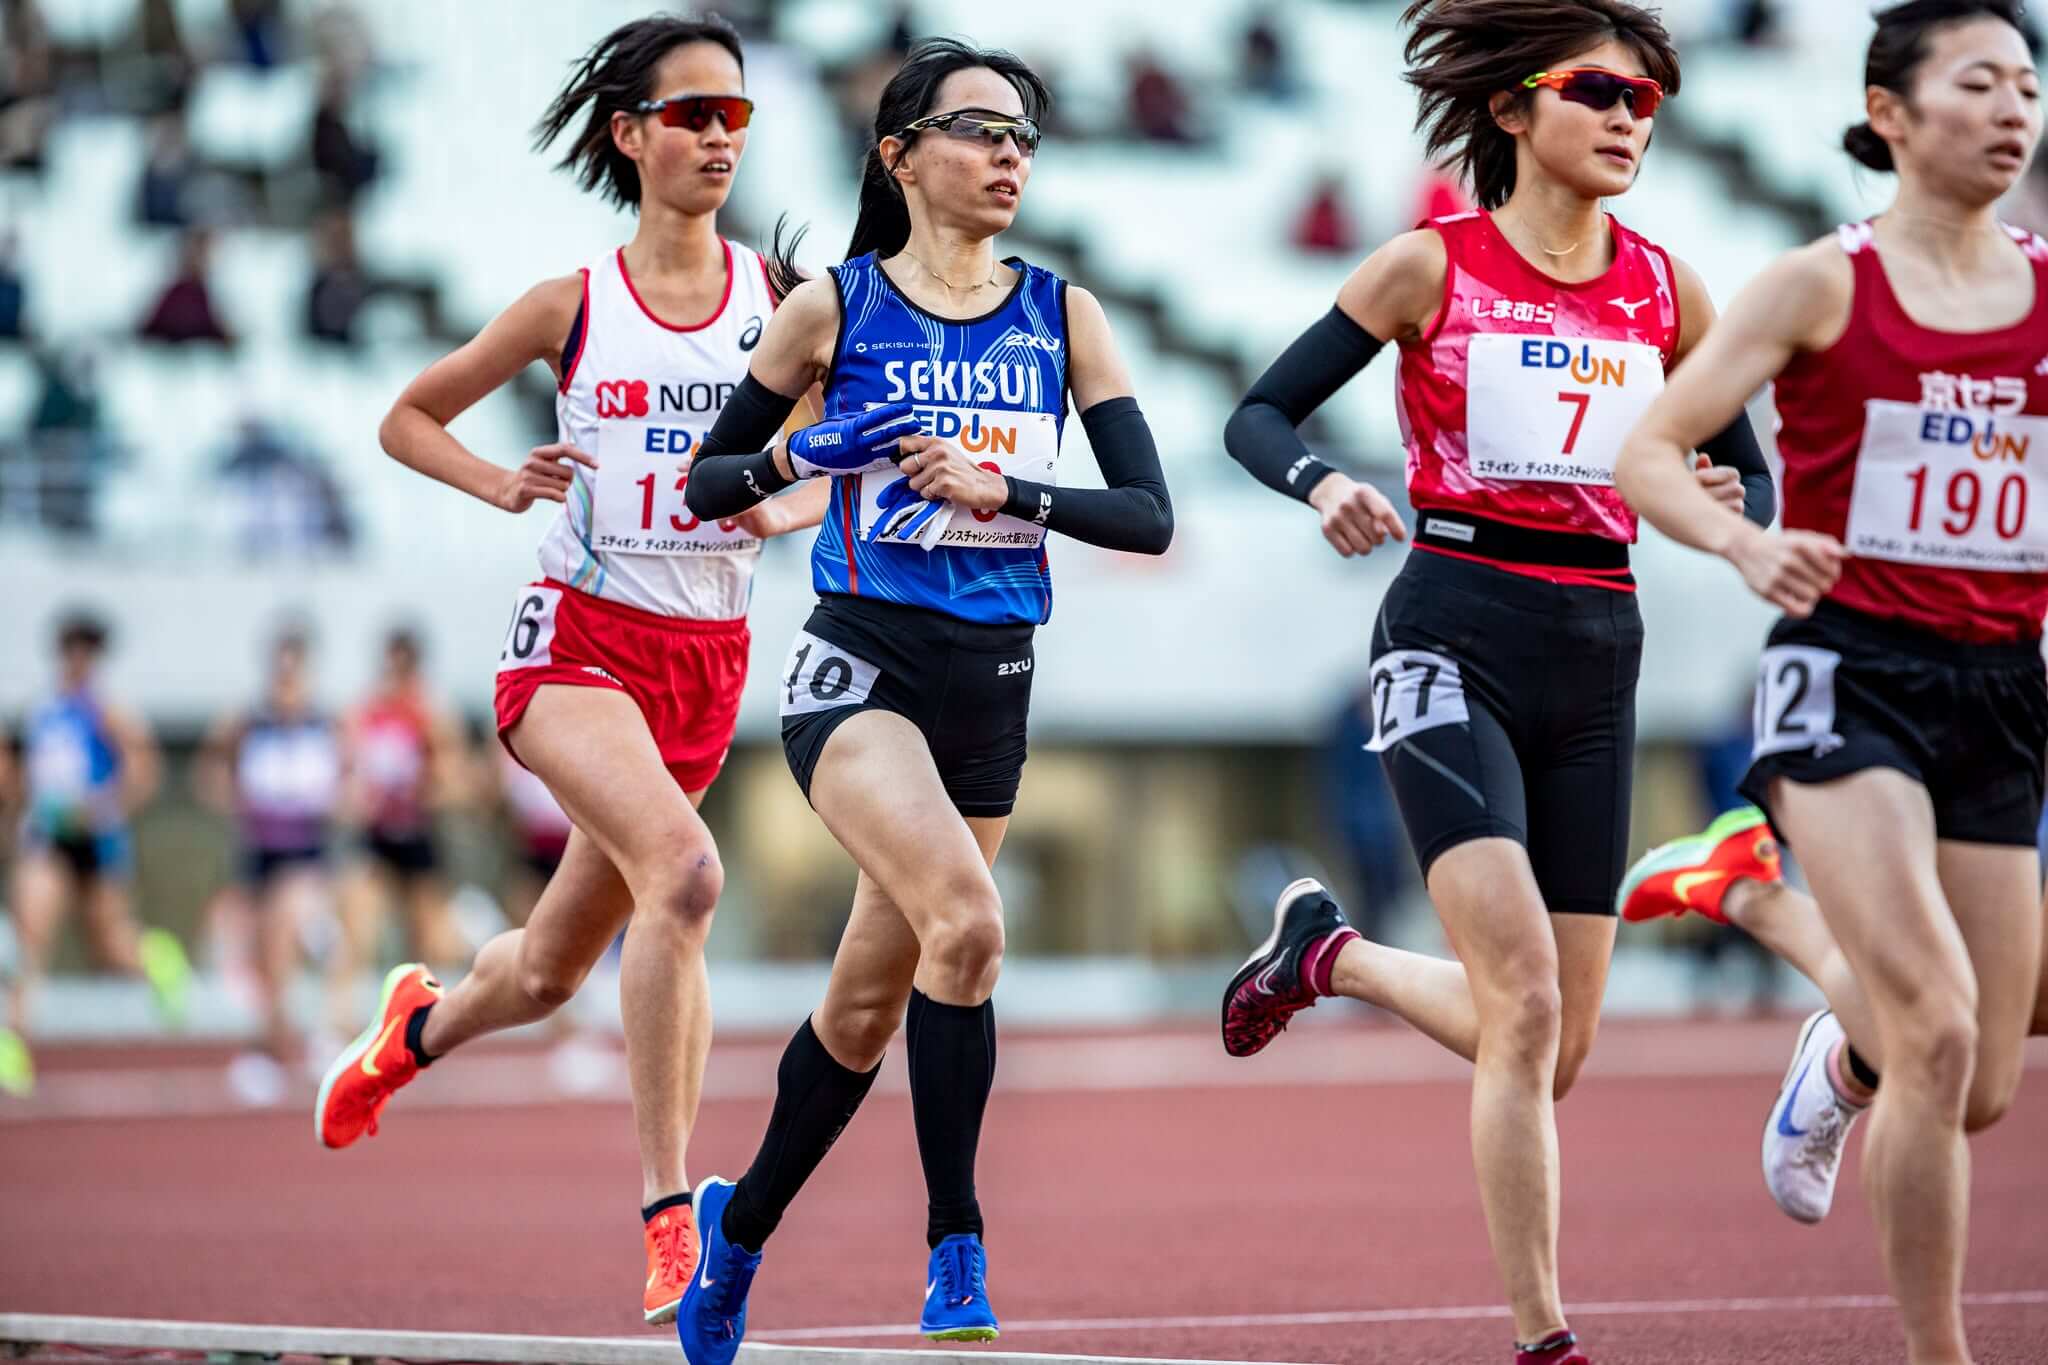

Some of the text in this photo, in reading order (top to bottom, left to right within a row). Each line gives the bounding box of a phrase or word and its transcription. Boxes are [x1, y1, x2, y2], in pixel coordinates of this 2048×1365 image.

[1471, 298, 1557, 323] しまむら
[871, 341, 914, 350] SEKISUI
[1006, 333, 1060, 351] 2XU
[1520, 339, 1626, 387] EDION
[660, 383, 738, 413] NOR
[884, 359, 1039, 409] SEKISUI
[1918, 370, 2028, 416] 京セラ
[808, 431, 843, 449] SEKISUI
[1558, 391, 1591, 456] 7
[1920, 411, 2030, 464] EDION
[635, 472, 738, 534] 13
[1905, 462, 2028, 541] 190
[501, 595, 544, 660] 6
[786, 643, 853, 705] 10
[997, 658, 1032, 676] 2XU
